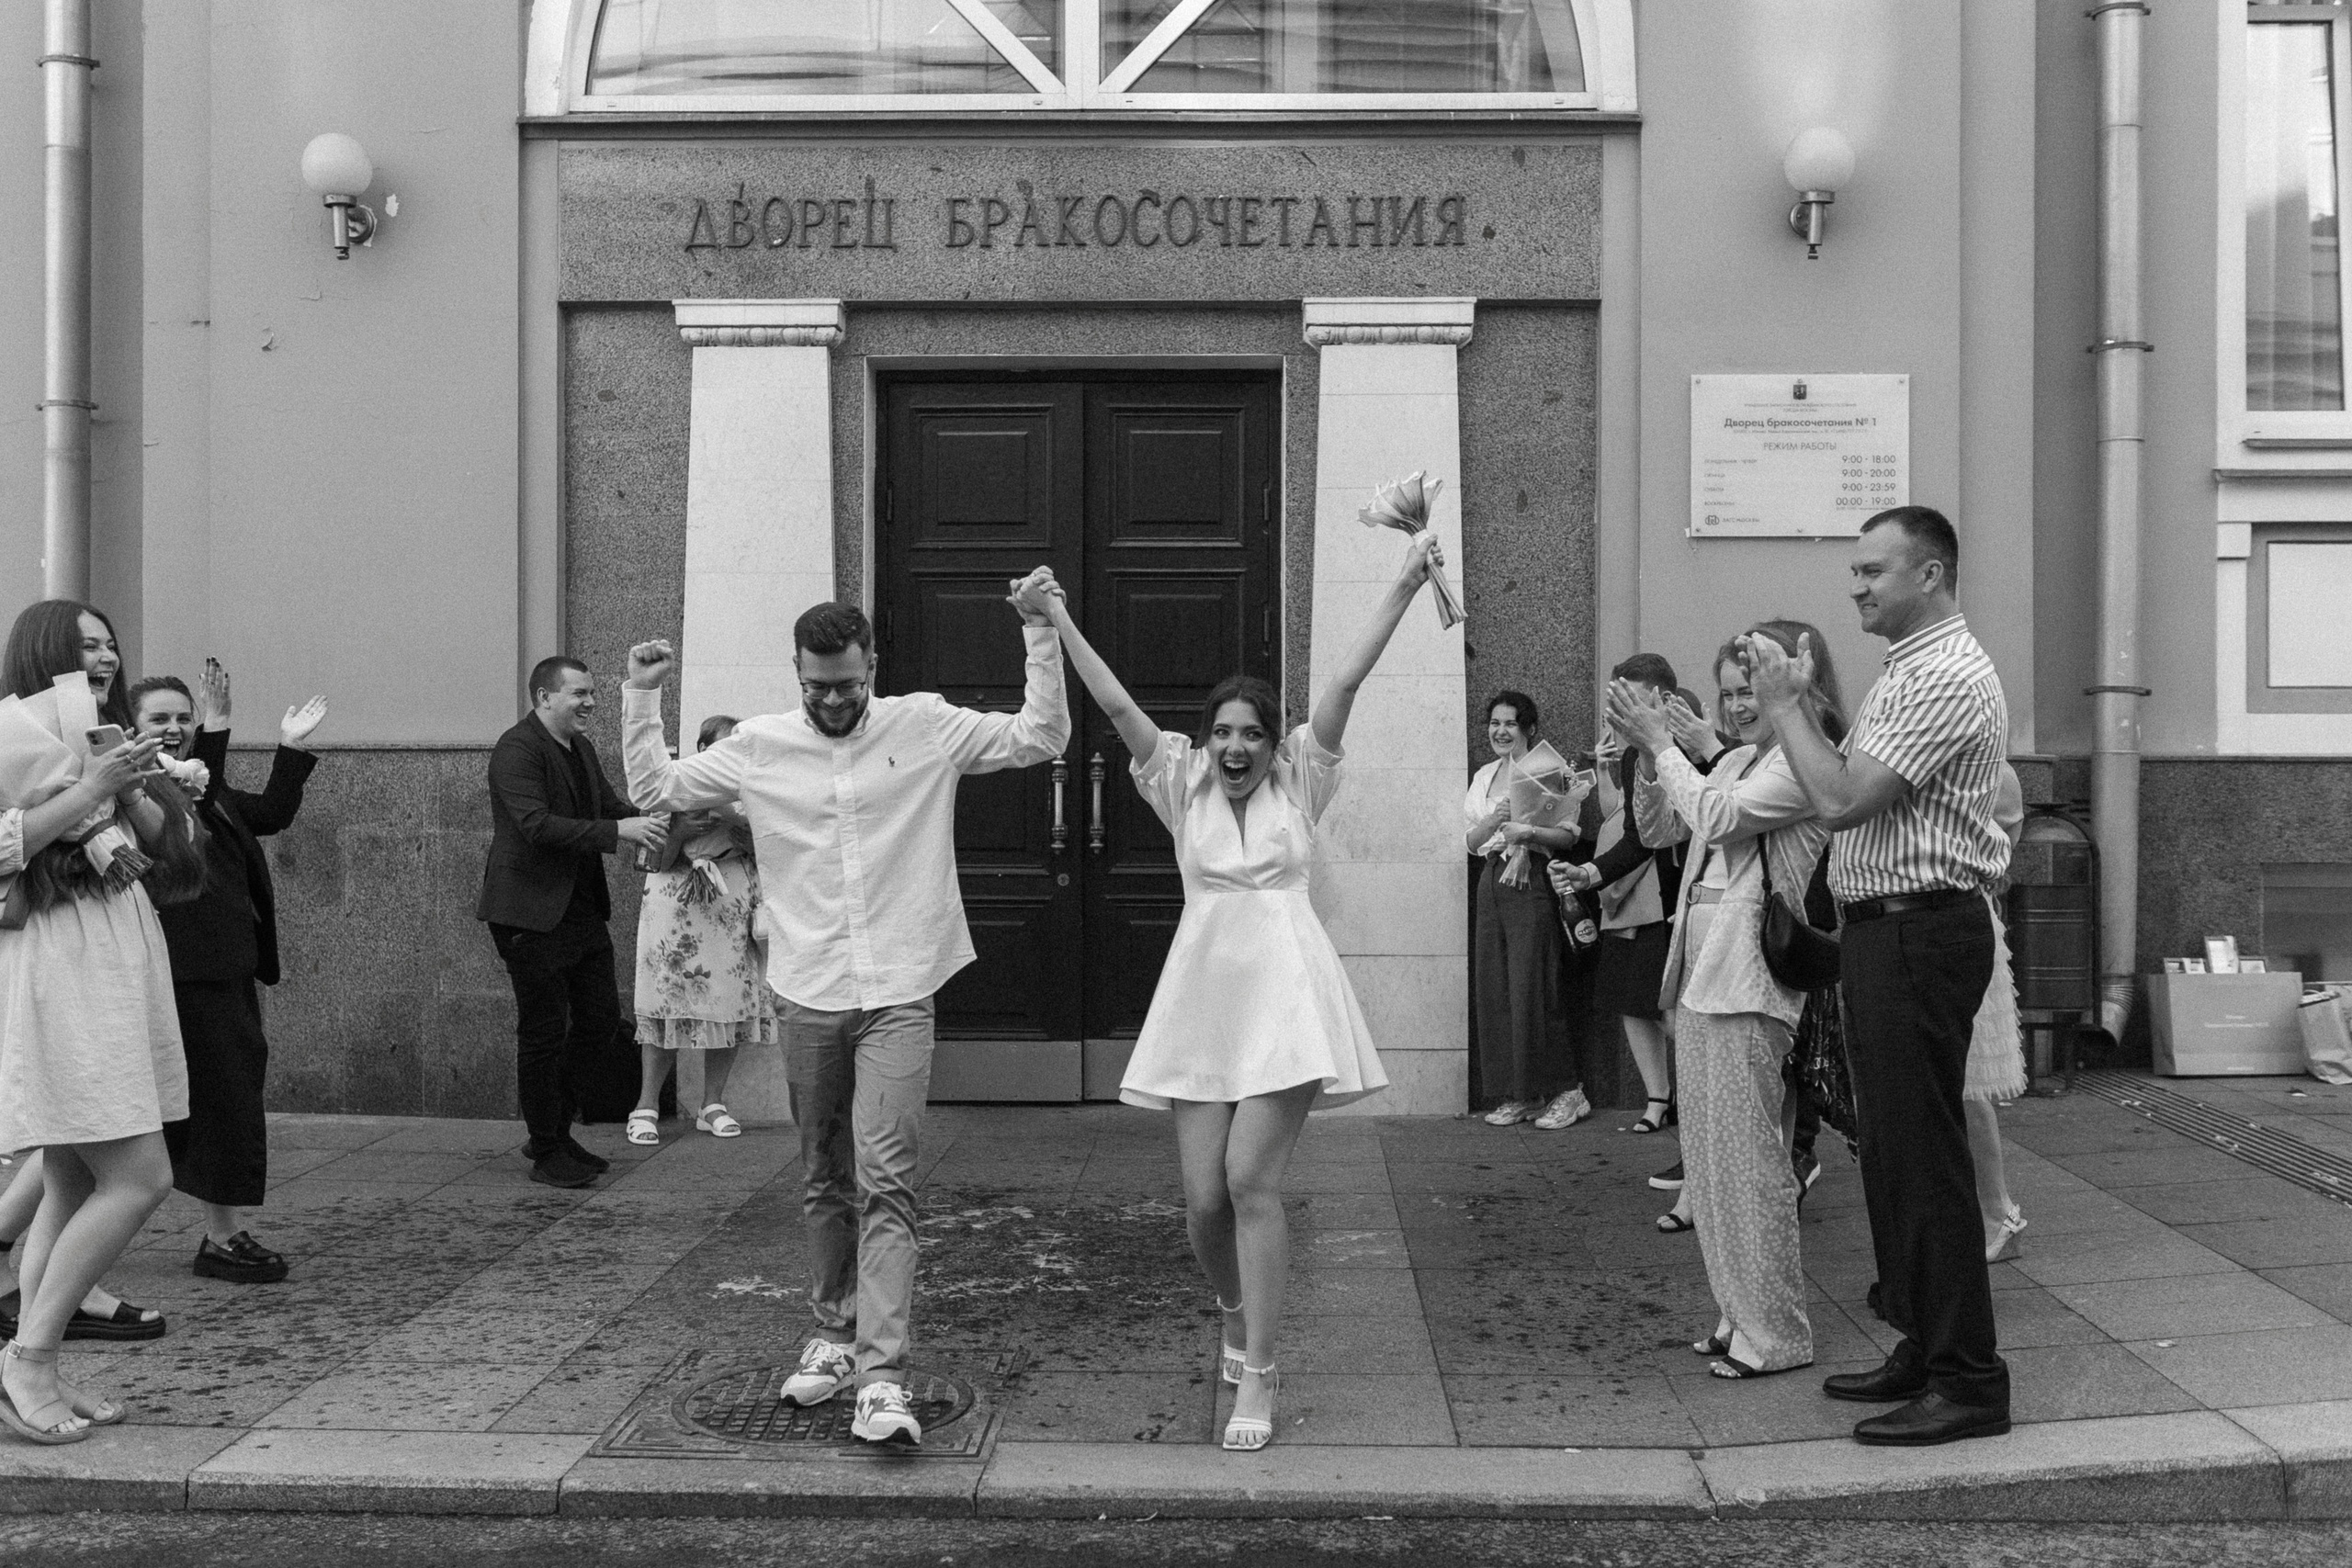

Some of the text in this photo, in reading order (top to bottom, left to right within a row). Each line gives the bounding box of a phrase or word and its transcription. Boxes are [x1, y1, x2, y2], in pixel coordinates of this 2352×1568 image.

[684, 194, 1465, 253] ДВОРЕЦ БРАКОСОЧЕТАНИЯ
[1724, 418, 1764, 429] Дворец
[1767, 418, 1852, 429] бракосочетания
[1872, 418, 1877, 426] 1
[1801, 442, 1837, 450] РАБОТЫ
[1842, 455, 1862, 463] 9:00
[1871, 455, 1895, 463] 18:00
[1842, 468, 1862, 477] 9:00
[1870, 468, 1895, 477] 20:00
[1842, 483, 1862, 491] 9:00
[1870, 483, 1895, 491] 23:59
[1836, 497, 1862, 505] 00:00
[1871, 497, 1895, 505] 19:00
